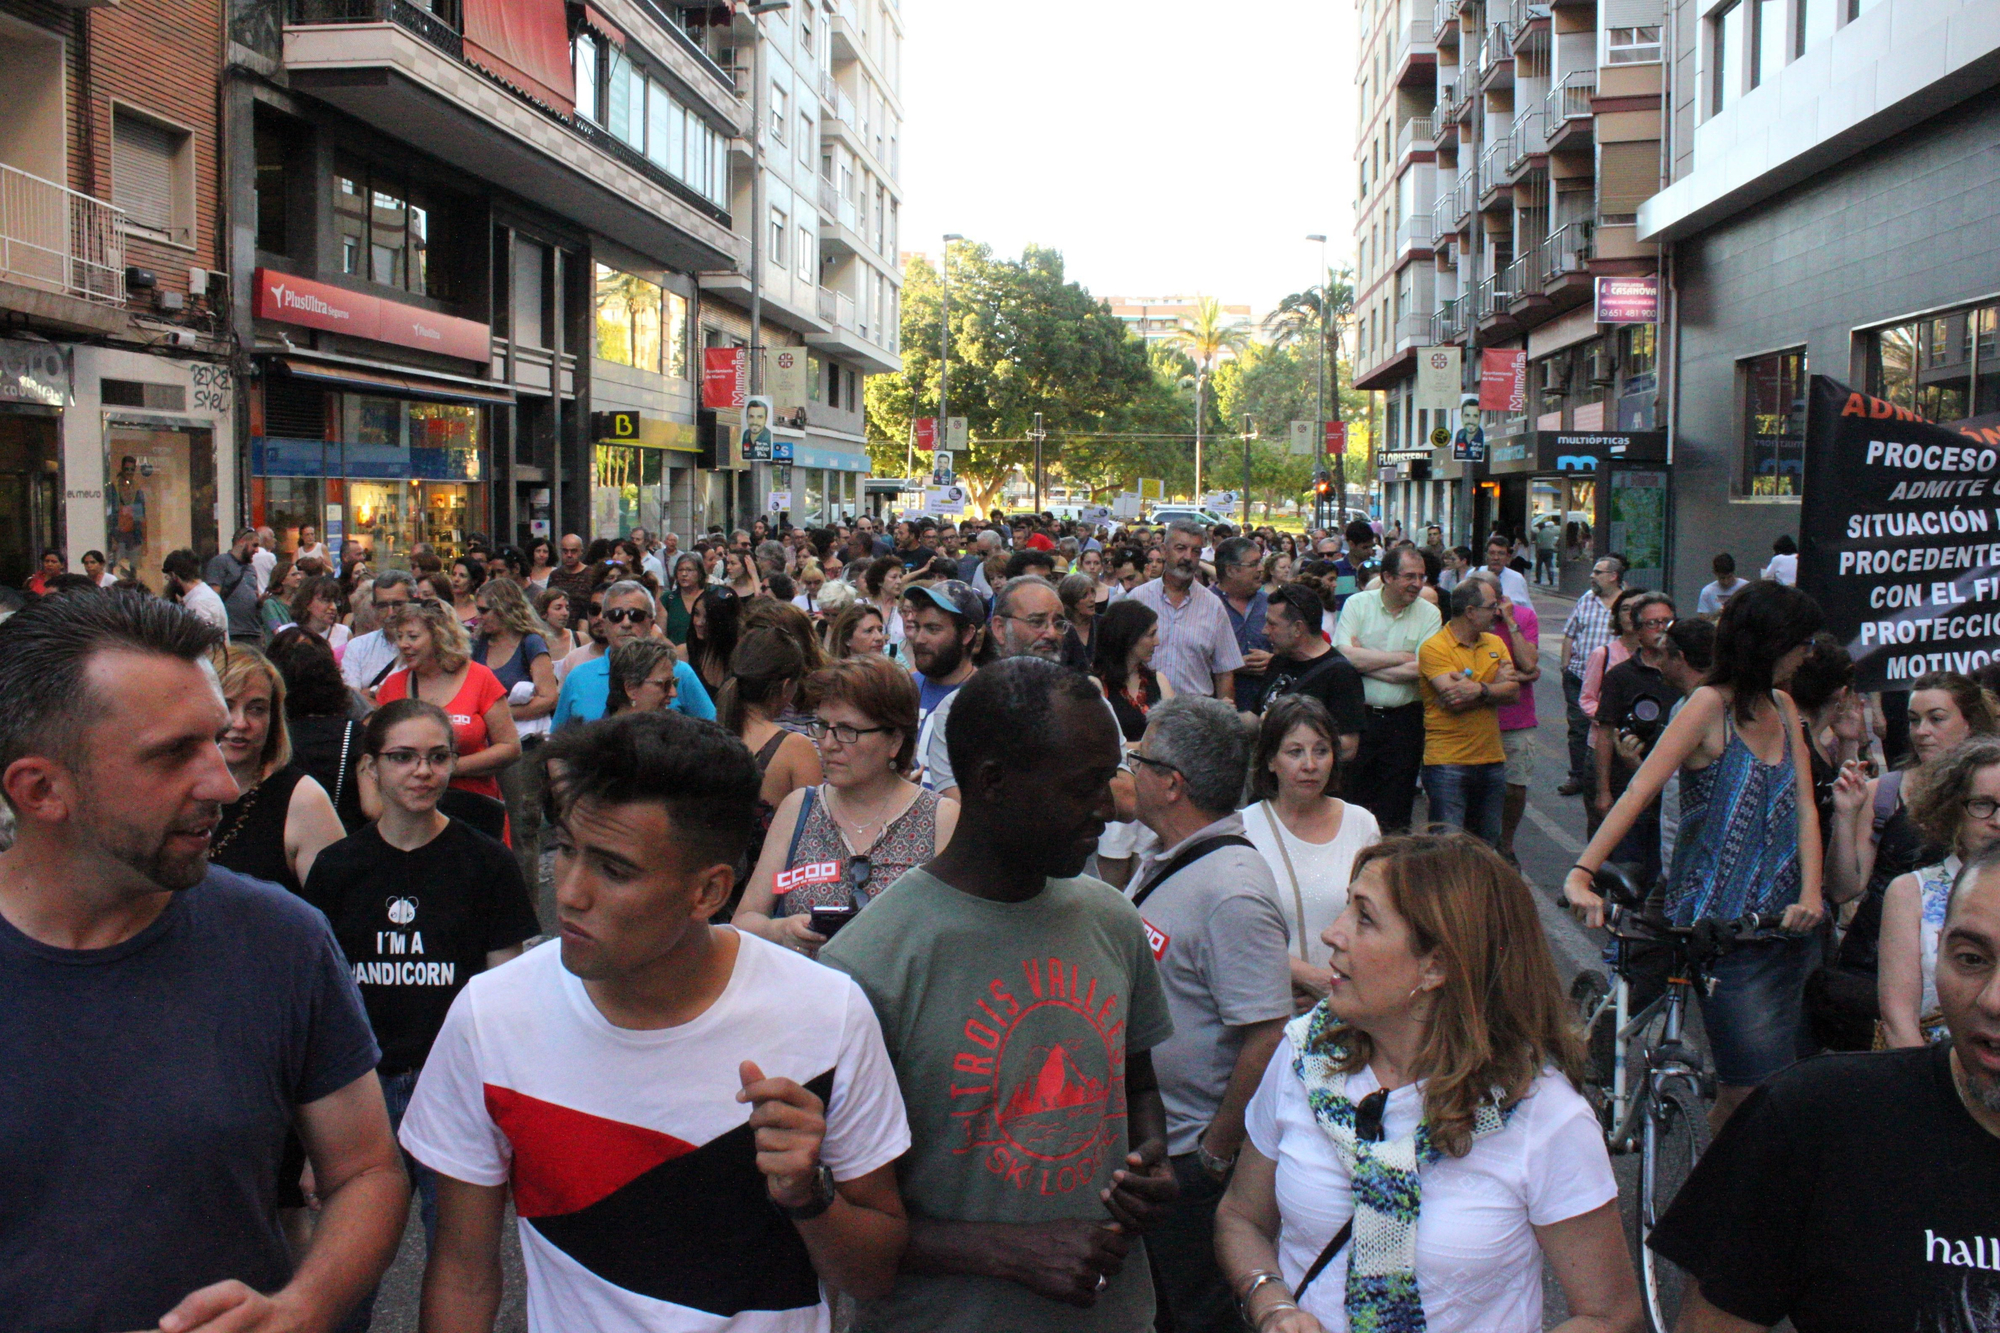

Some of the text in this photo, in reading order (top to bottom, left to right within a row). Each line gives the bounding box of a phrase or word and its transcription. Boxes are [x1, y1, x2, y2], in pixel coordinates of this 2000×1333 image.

[284, 289, 350, 320] PlusUltra Seguros
[1611, 287, 1657, 295] CASANOVA
[1609, 309, 1657, 317] 651 481 900
[418, 325, 441, 340] PlusUltra
[732, 348, 745, 407] Murcia
[1509, 351, 1527, 411] Murcia
[615, 415, 633, 435] B
[1866, 440, 1997, 472] PROCESO
[1888, 479, 1989, 500] ADMITE
[1847, 505, 1989, 539] SITUACIÓN
[1870, 583, 1922, 609] CON
[1931, 581, 1966, 606] EL
[777, 862, 836, 888] CCOO
[411, 931, 424, 954] A
[950, 978, 1020, 1100] TROIS
[985, 1145, 1033, 1190] SKI
